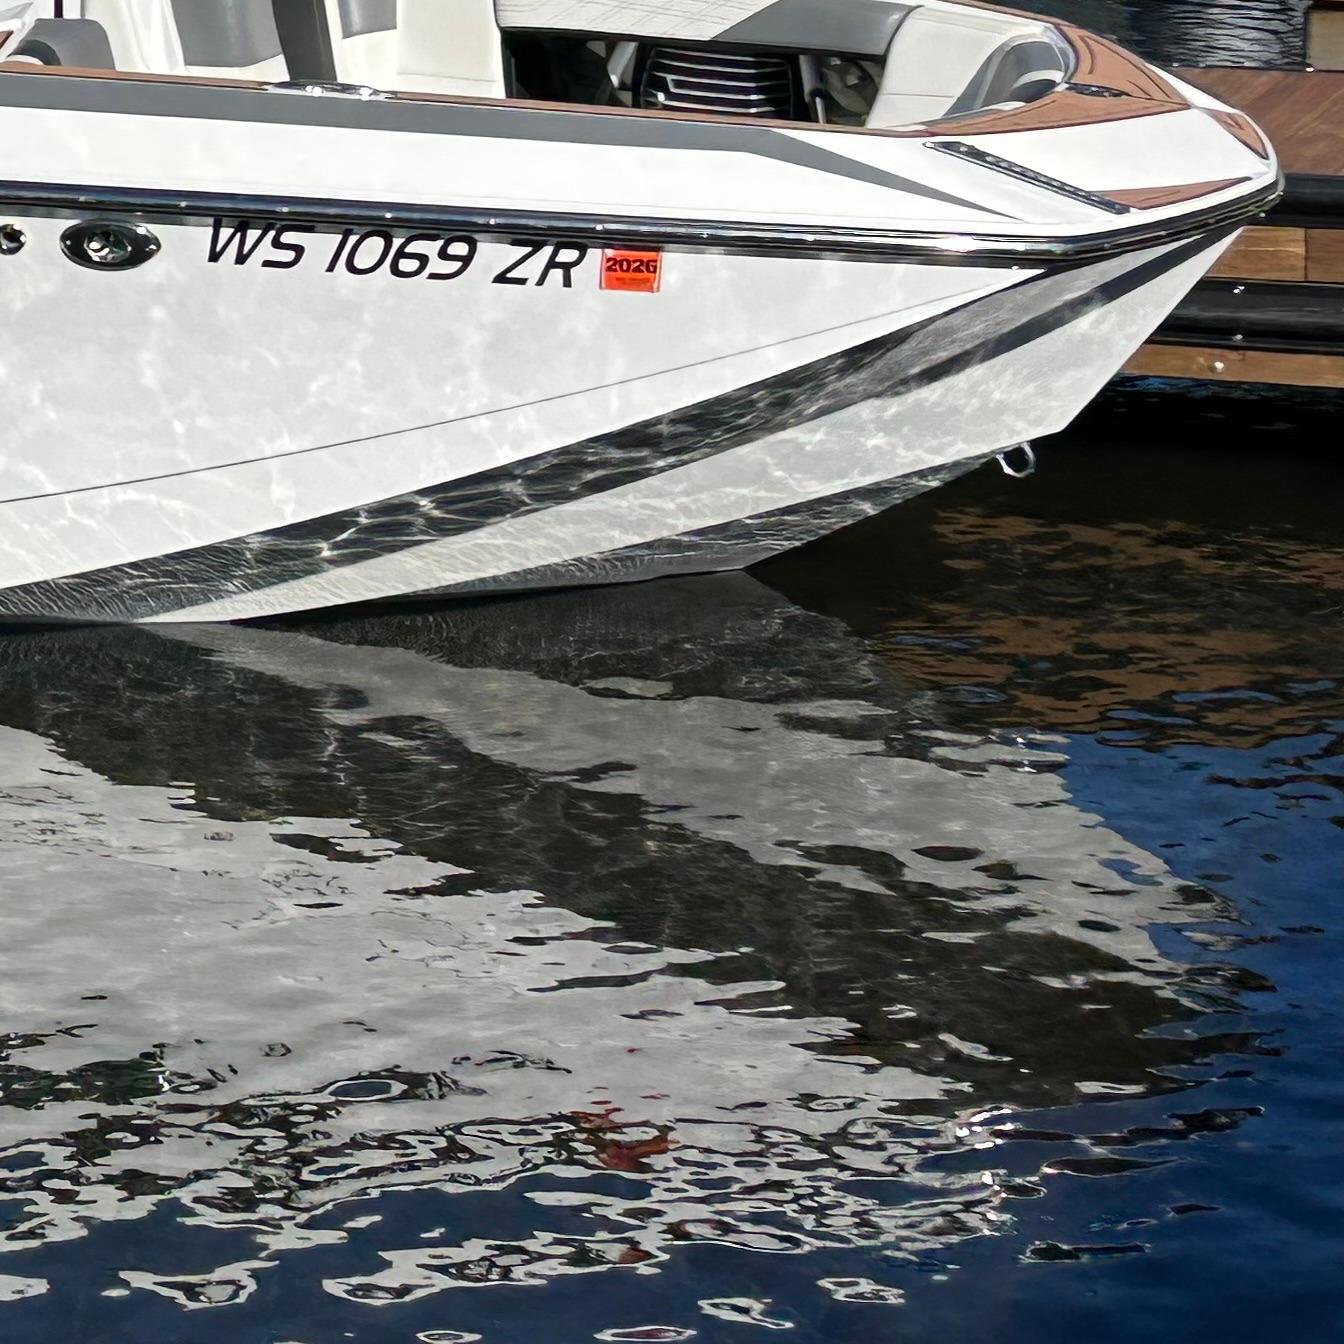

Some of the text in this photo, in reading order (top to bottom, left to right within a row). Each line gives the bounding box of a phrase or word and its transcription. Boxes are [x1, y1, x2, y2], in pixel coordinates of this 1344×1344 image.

[207, 216, 589, 288] WS 1069 ZR
[605, 257, 658, 274] 2026
